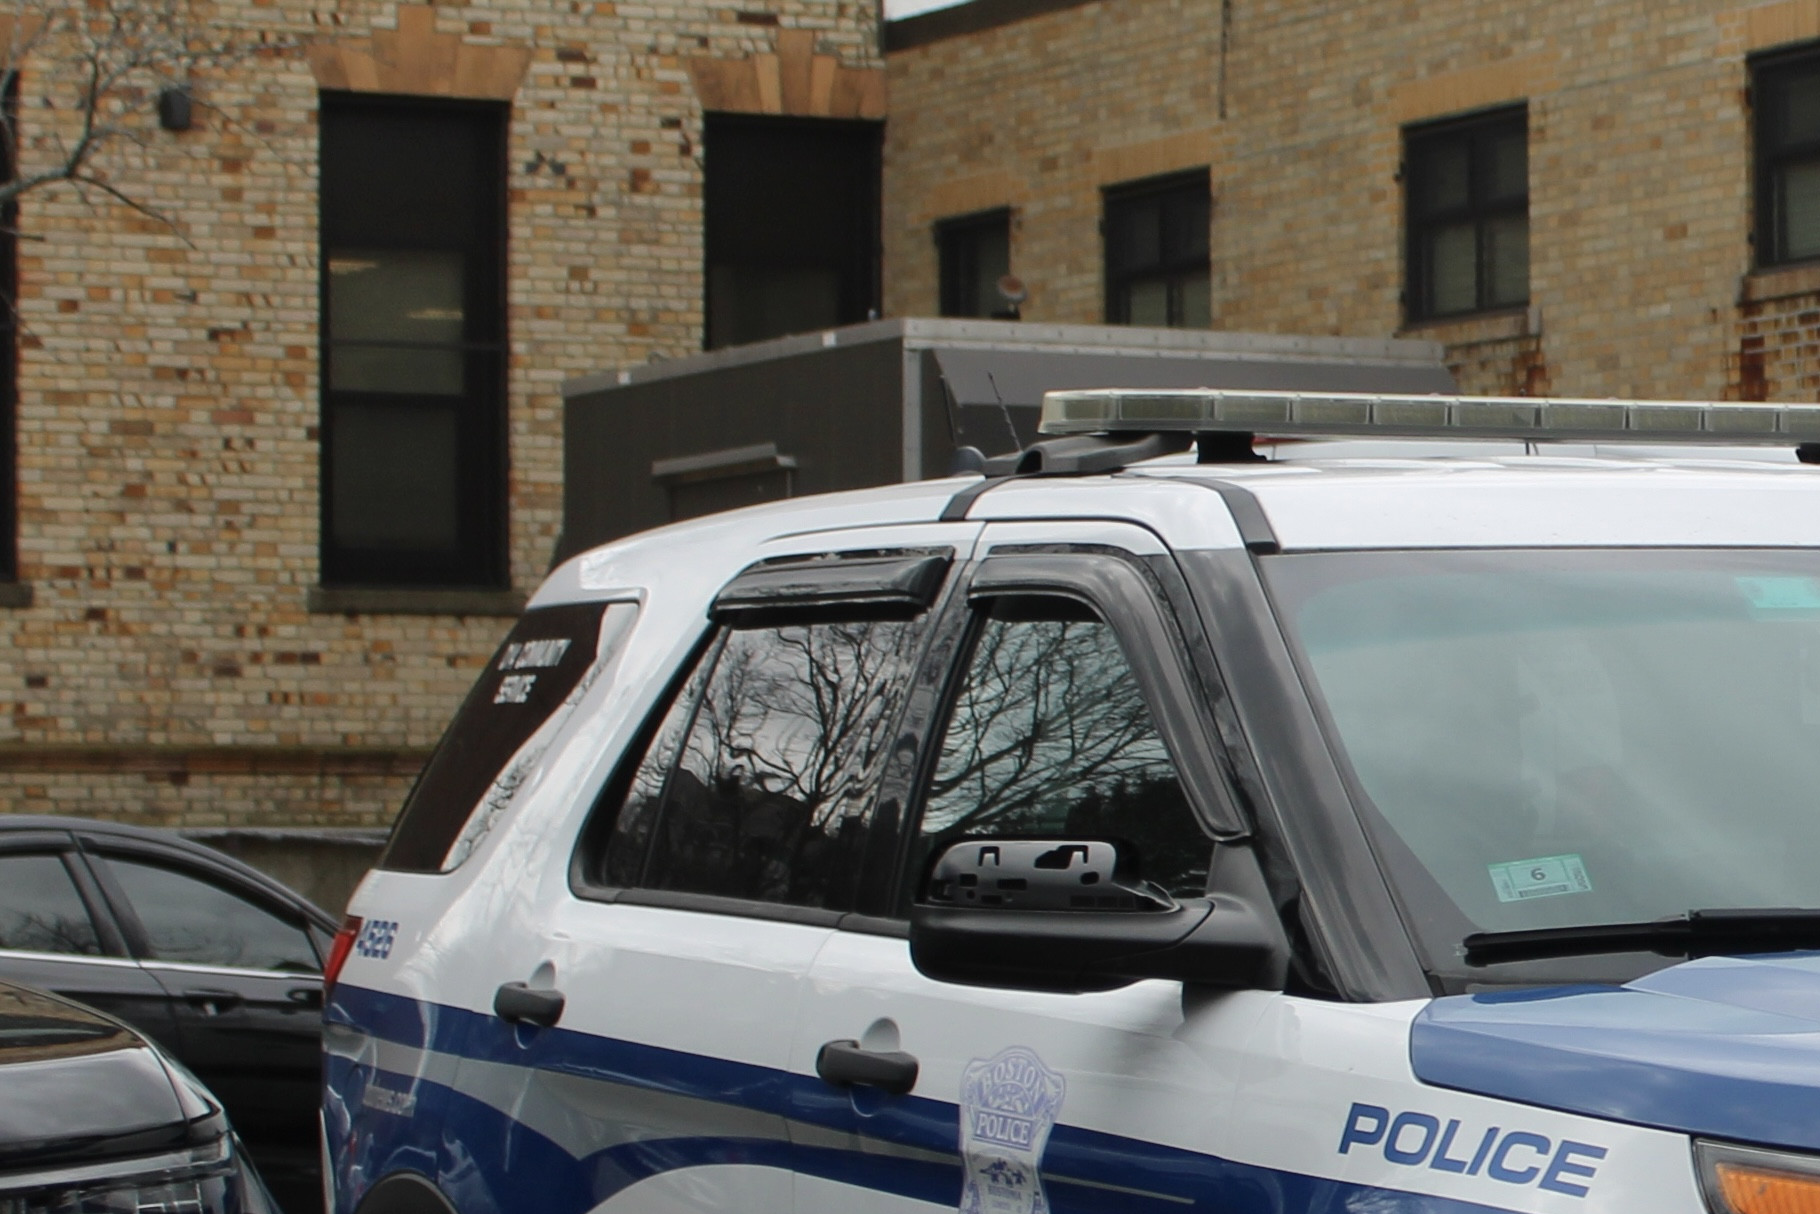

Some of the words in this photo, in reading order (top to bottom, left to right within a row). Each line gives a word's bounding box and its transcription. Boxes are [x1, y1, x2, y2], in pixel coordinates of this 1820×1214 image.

[1530, 867, 1546, 881] 6
[982, 1059, 1041, 1104] BOSTON
[977, 1112, 1031, 1145] POLICE
[1338, 1101, 1609, 1198] POLICE
